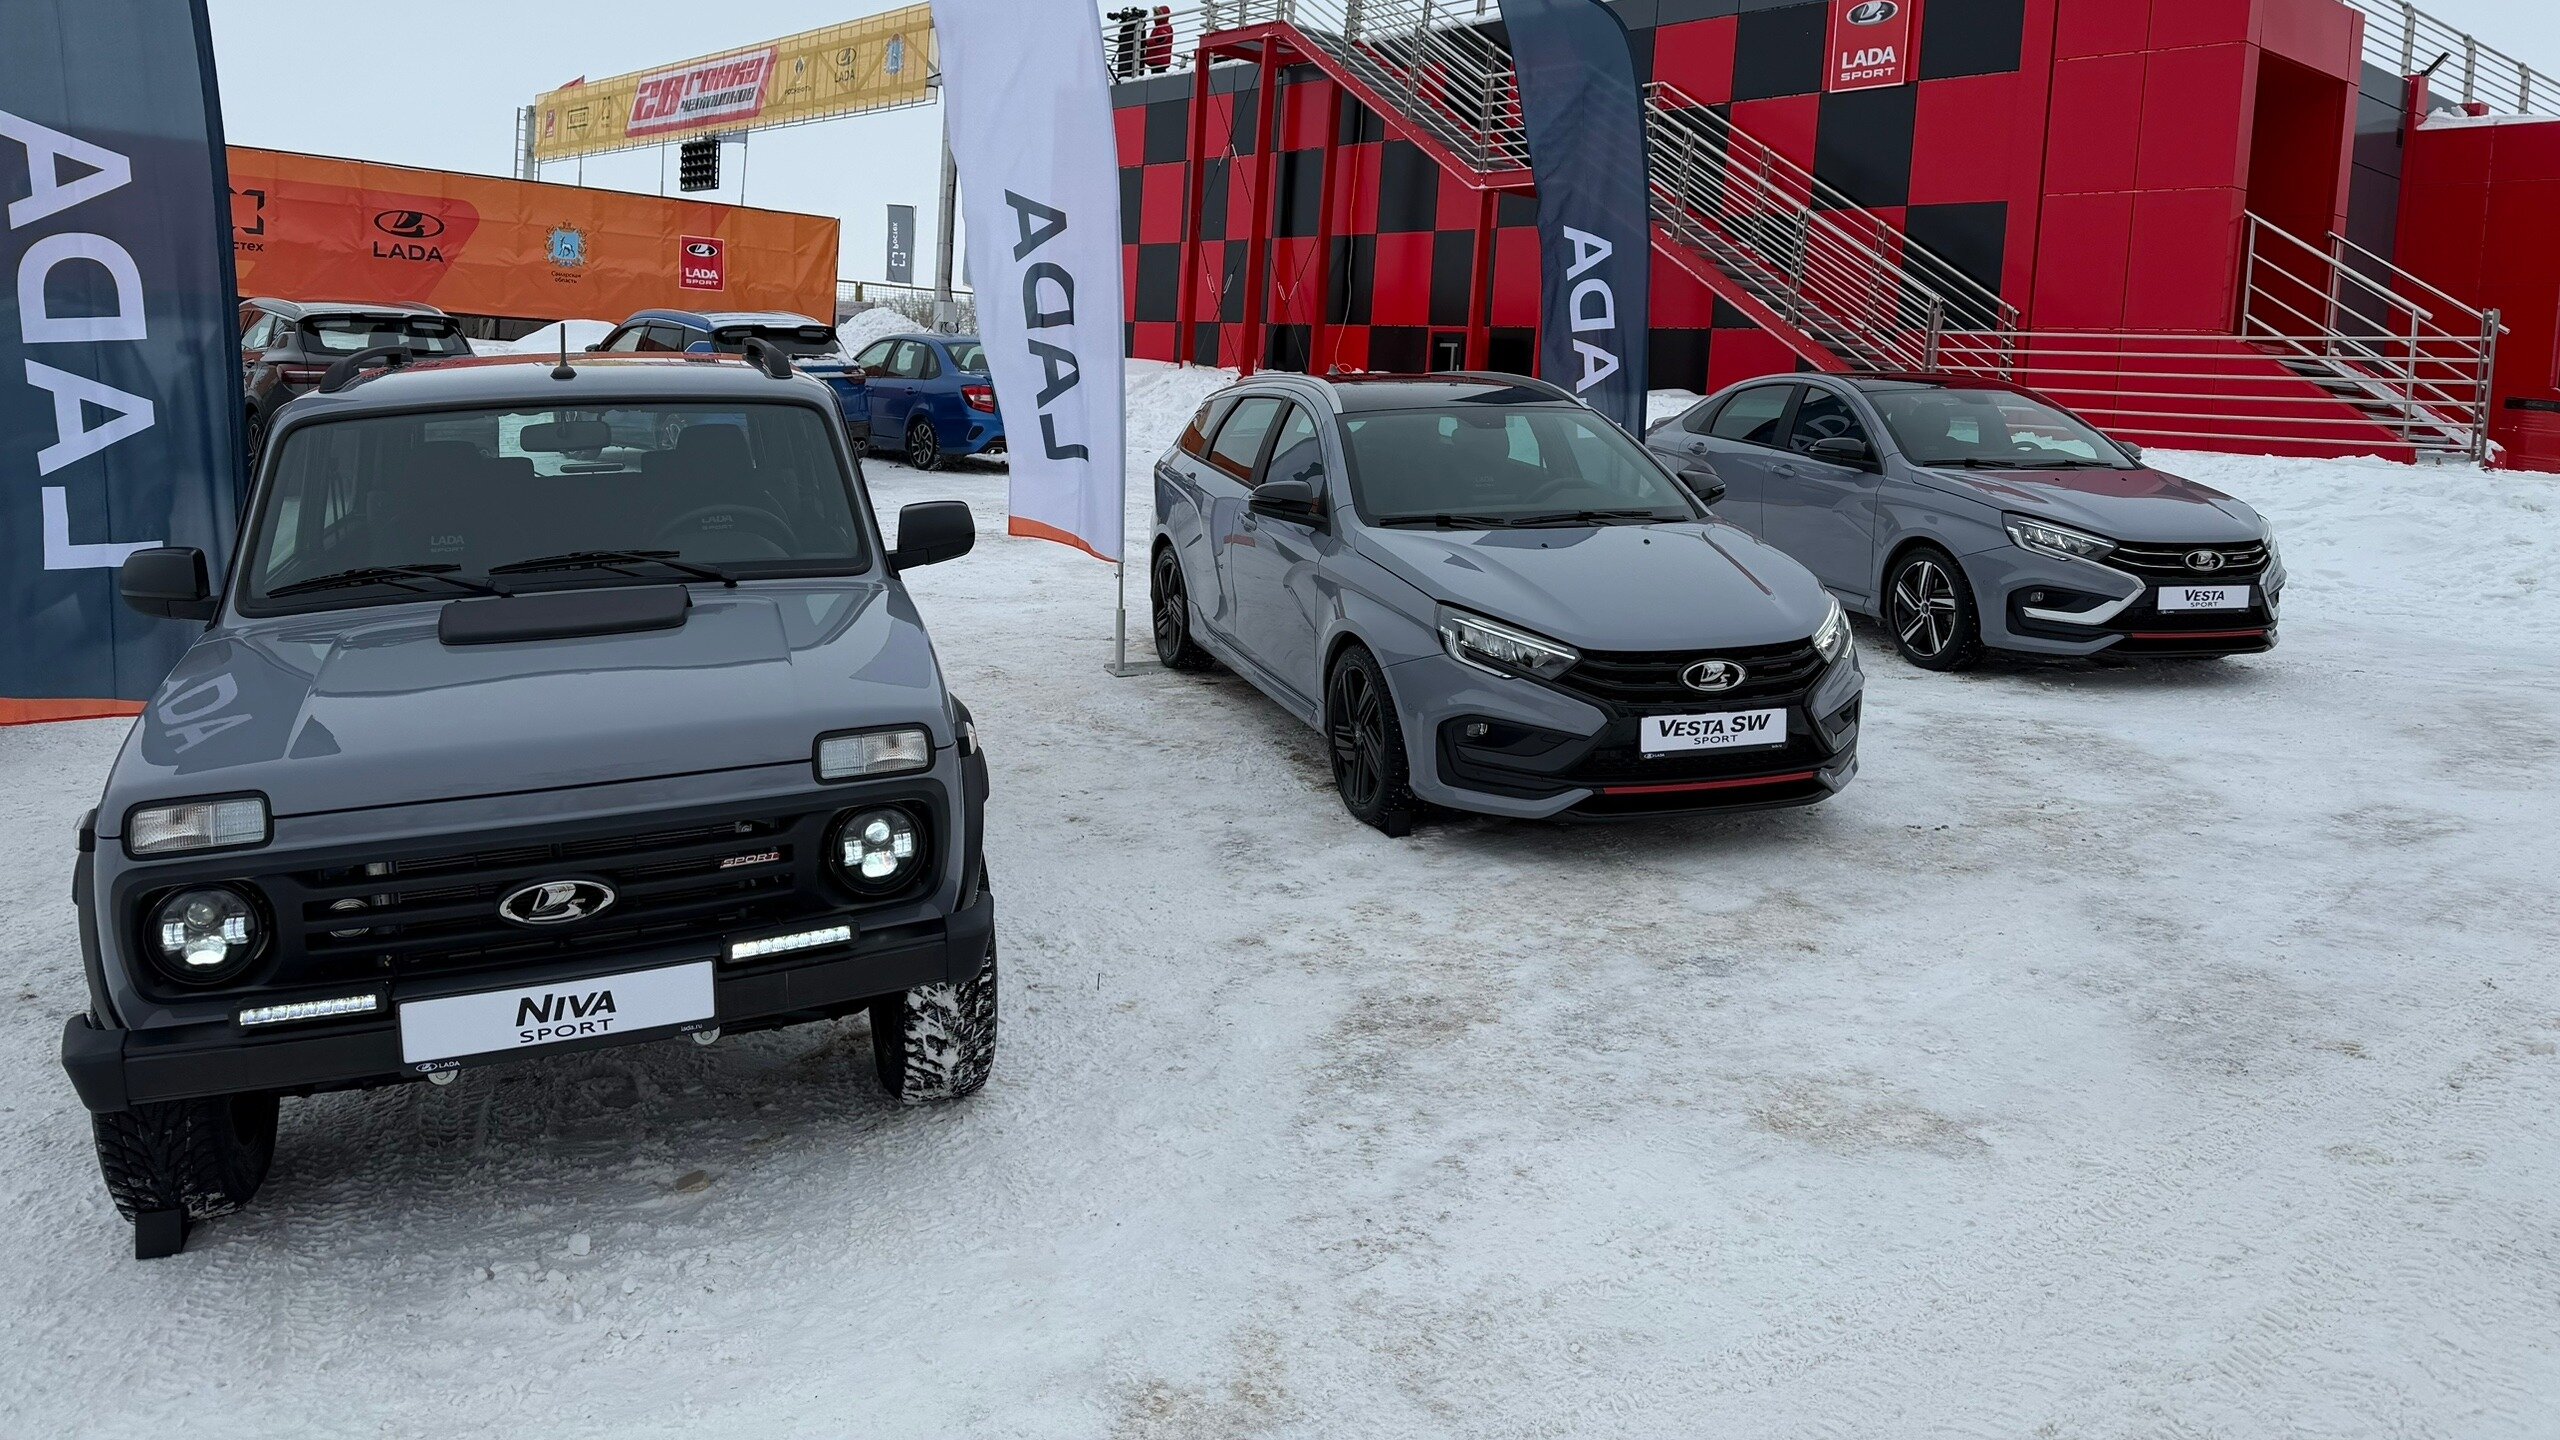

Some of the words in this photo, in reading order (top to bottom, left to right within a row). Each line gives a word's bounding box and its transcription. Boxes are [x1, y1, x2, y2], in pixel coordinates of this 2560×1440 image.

[1841, 45, 1896, 69] LADA
[834, 70, 856, 83] LADA
[1840, 67, 1895, 81] SPORT
[631, 74, 687, 121] 20
[233, 241, 264, 252] стех
[372, 240, 445, 263] LADA
[685, 267, 719, 280] LADA
[685, 278, 719, 286] SPORT
[430, 534, 465, 546] LADA
[2184, 589, 2224, 602] VESTA
[1658, 718, 1724, 738] VESTA
[1730, 713, 1771, 733] SW
[1693, 734, 1739, 746] SPORT
[721, 851, 779, 868] SPORT
[515, 990, 618, 1028] NIVA
[519, 1018, 614, 1044] SPORT
[438, 1060, 461, 1069] LADA
